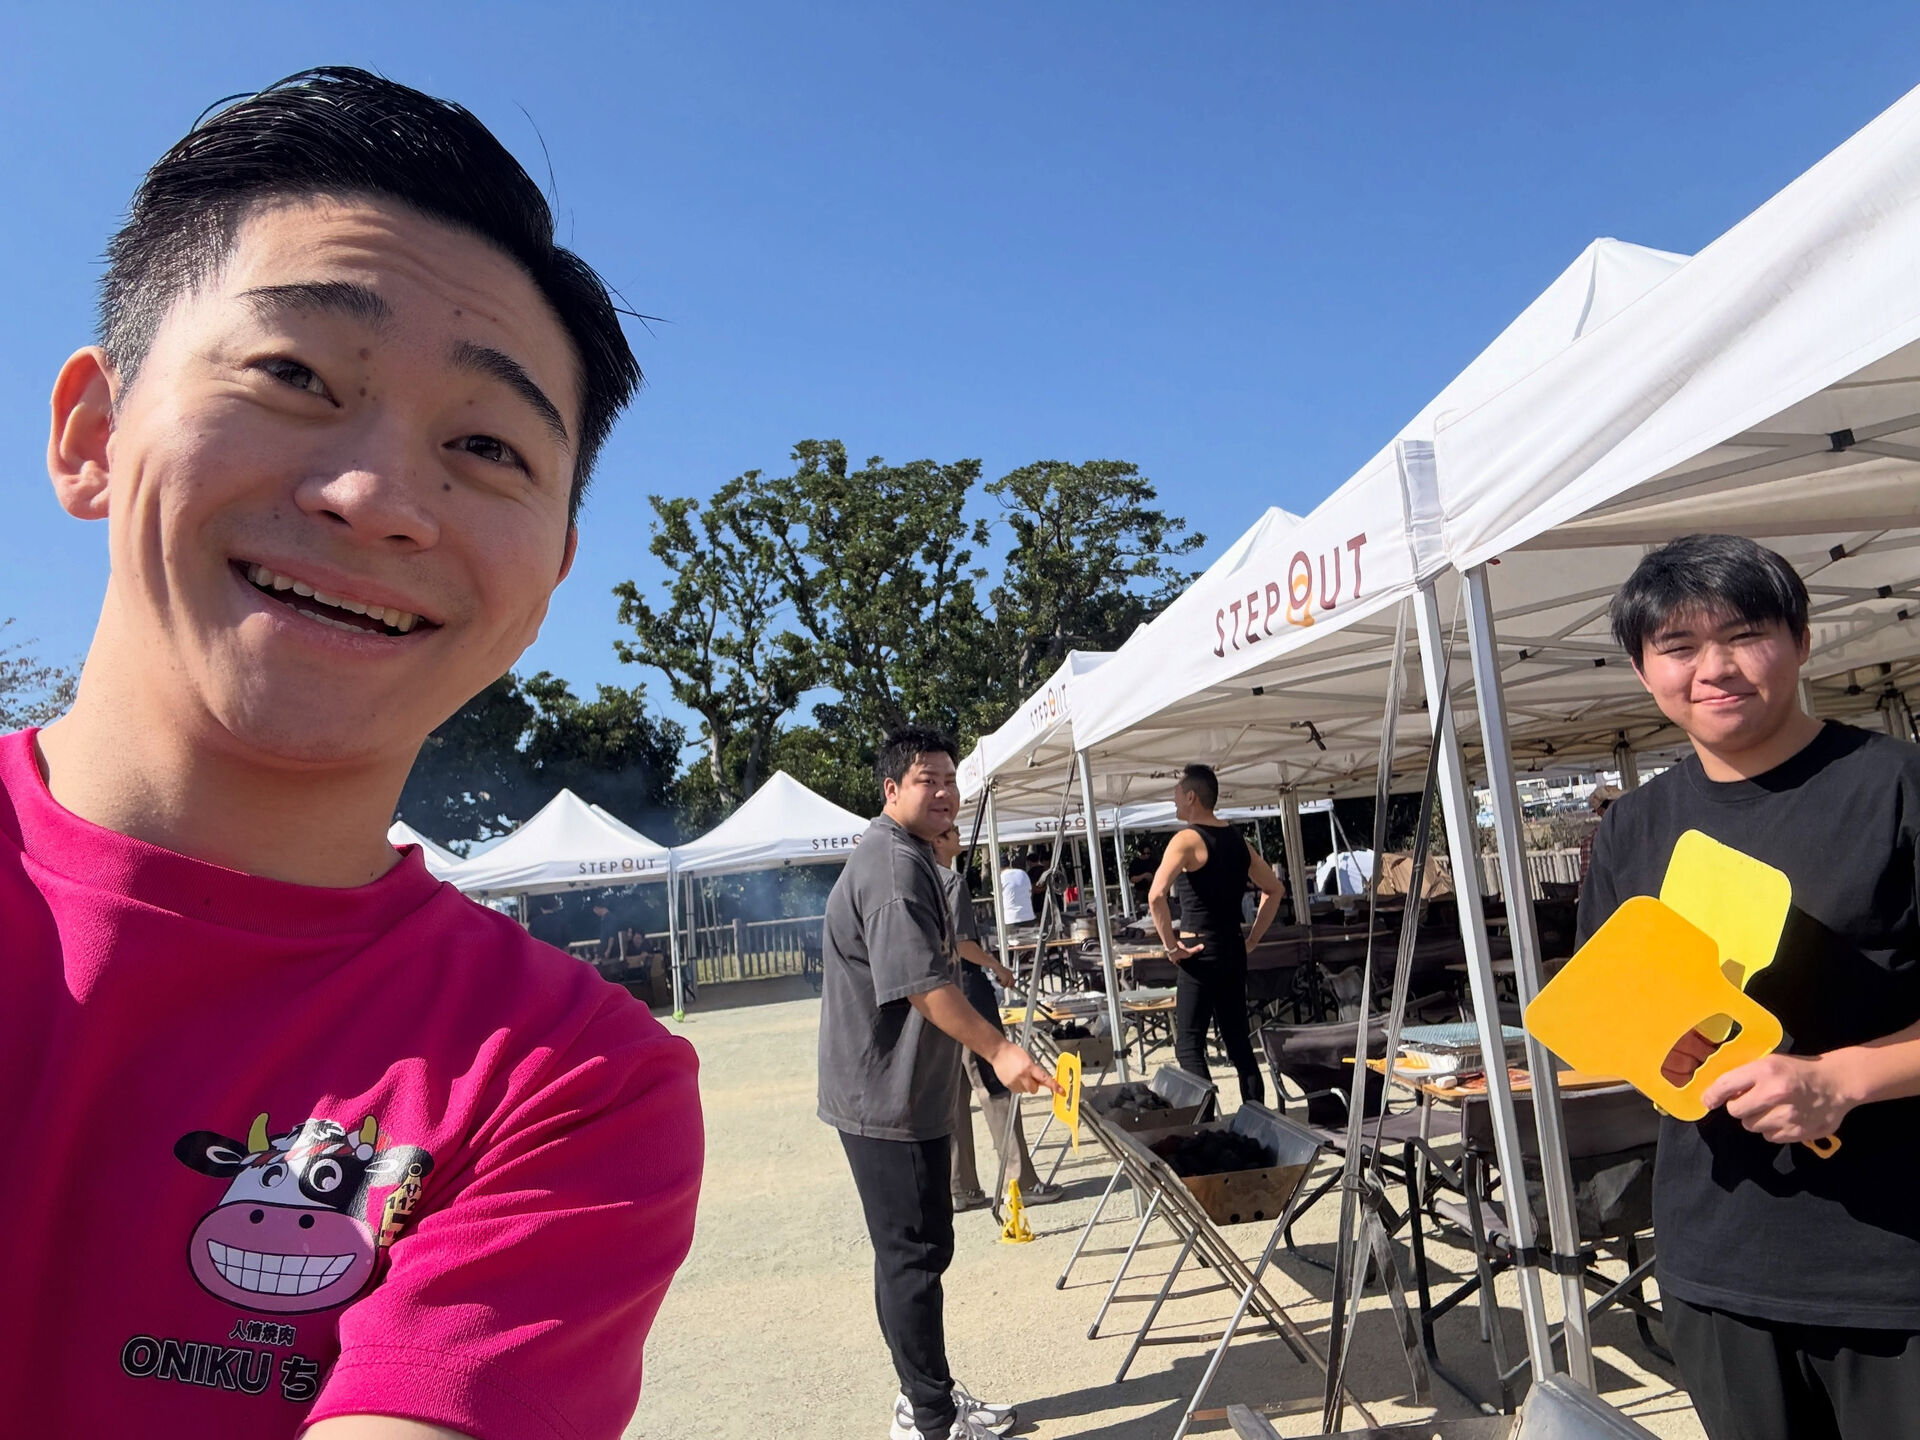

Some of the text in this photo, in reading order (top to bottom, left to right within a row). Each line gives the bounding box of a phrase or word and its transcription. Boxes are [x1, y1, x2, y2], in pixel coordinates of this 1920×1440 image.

[1213, 532, 1367, 658] STEPOUT
[1035, 817, 1107, 832] STEPOT
[579, 858, 655, 874] STEPOUT
[122, 1336, 318, 1401] ONIKU ち
